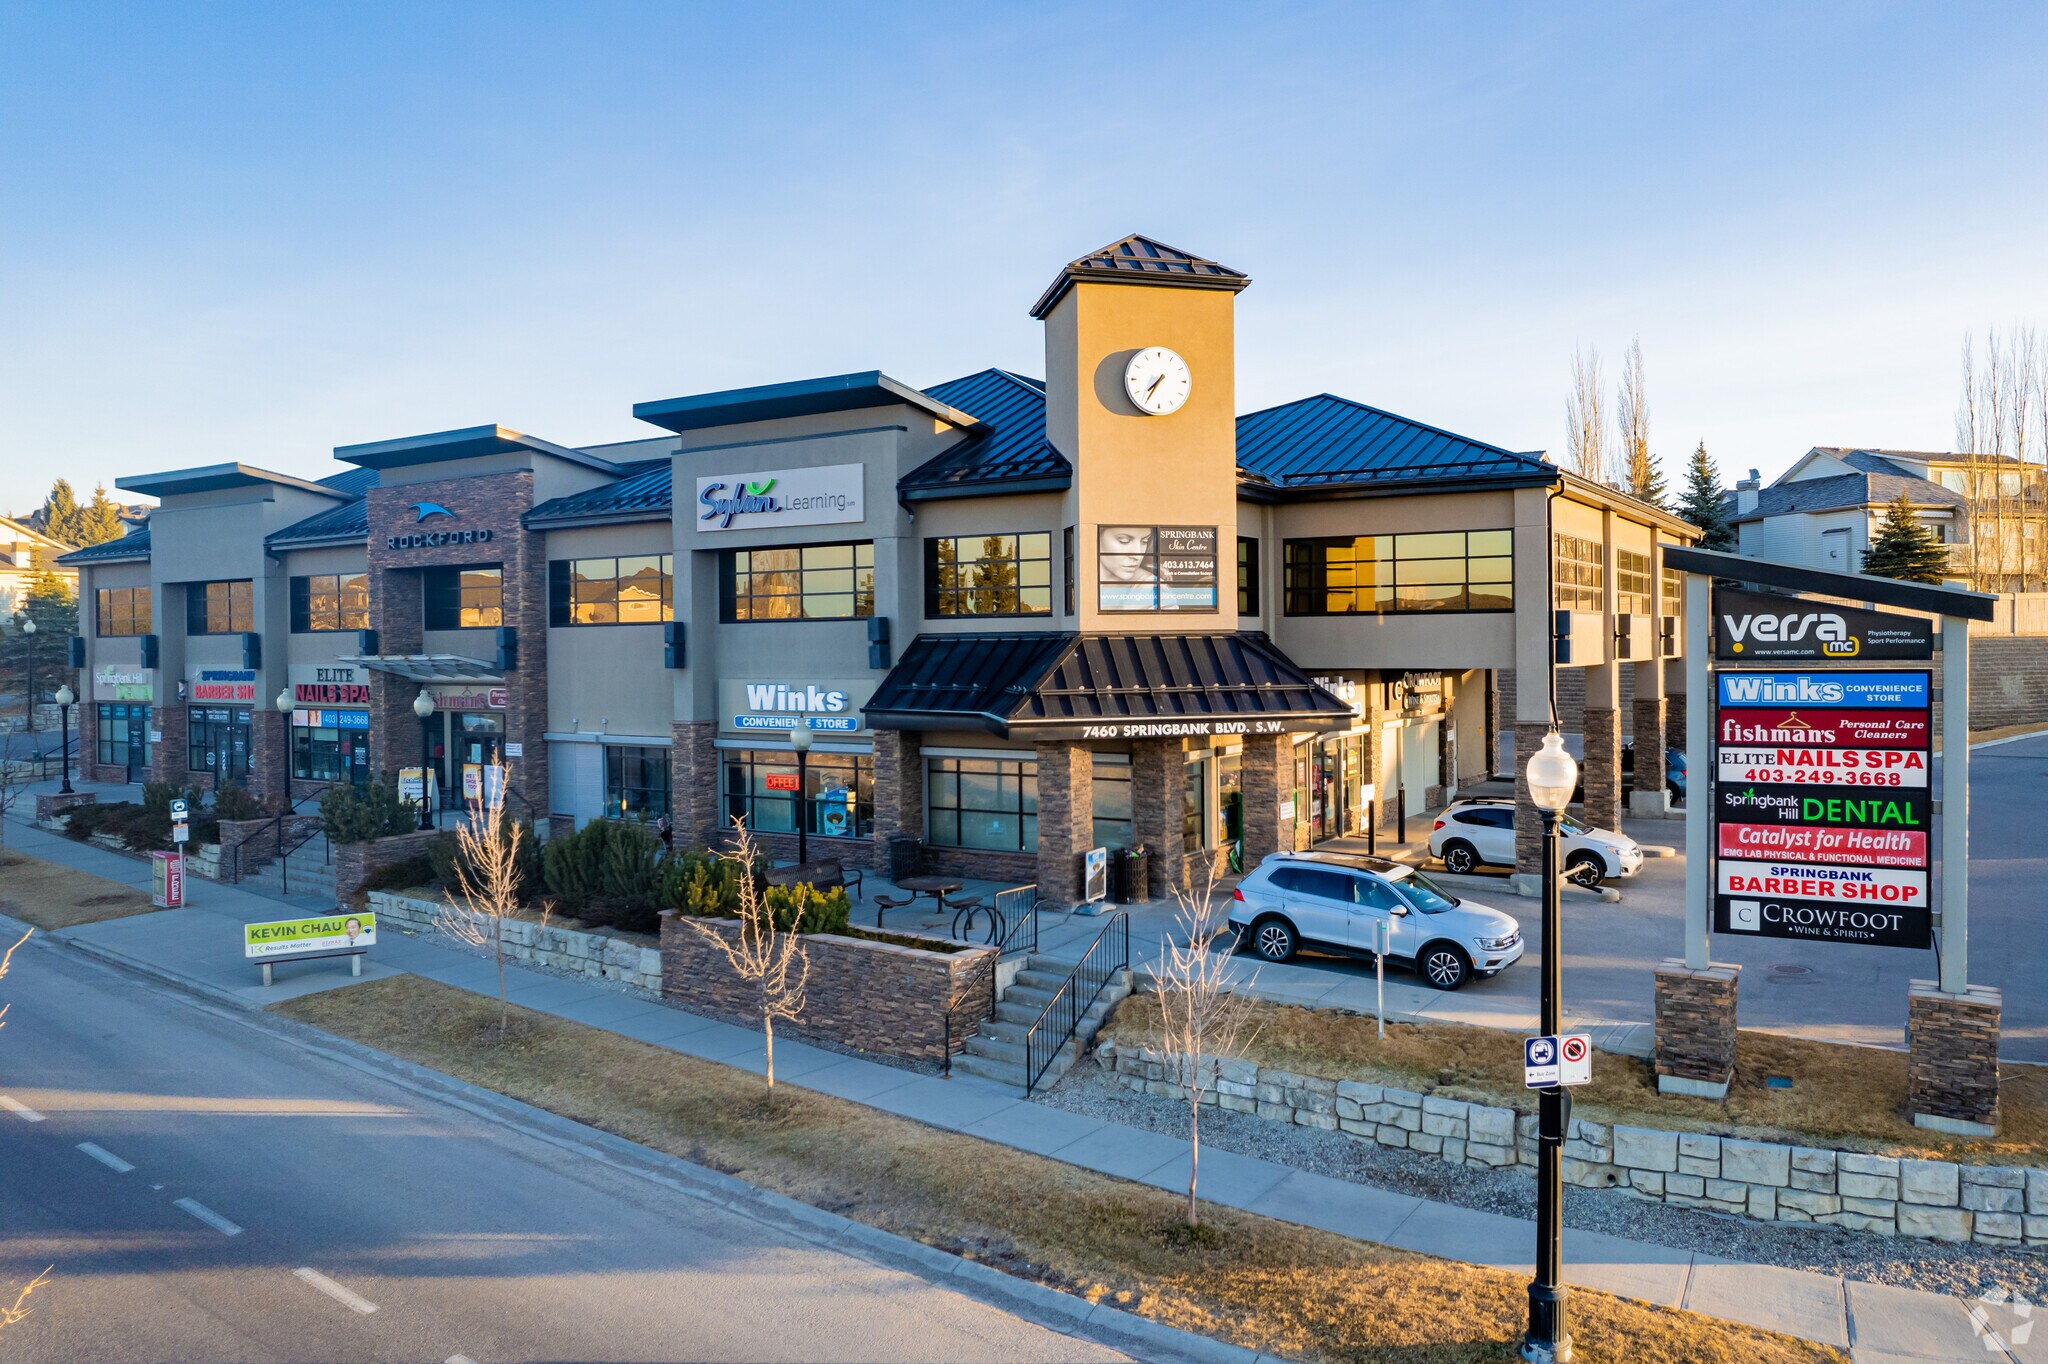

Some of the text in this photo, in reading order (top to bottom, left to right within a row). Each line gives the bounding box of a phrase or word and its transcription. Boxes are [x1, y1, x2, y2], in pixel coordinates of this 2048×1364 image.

[700, 482, 782, 528] Sylvan
[785, 493, 846, 511] Learning
[386, 529, 492, 549] ROCKFORD
[1160, 530, 1214, 539] SPRINGBANK
[1168, 540, 1208, 550] Skin Centre
[1162, 560, 1214, 568] 403.613.7464
[1724, 613, 1847, 642] versa
[1868, 630, 1912, 638] Physiotherapy
[1830, 640, 1853, 652] mc
[96, 672, 130, 686] Springbank
[316, 668, 354, 682] ELITE
[1404, 671, 1441, 689] CROWFOOT
[194, 685, 234, 700] BARBER
[296, 684, 369, 704] NAILS SPA
[1723, 676, 1844, 702] Winks
[1846, 684, 1922, 692] CONVENIENCE
[746, 684, 846, 712] Winks
[1866, 694, 1902, 702] STORE
[322, 714, 368, 724] (403) 249-3668
[742, 717, 848, 728] CONVENIENE STORE
[1839, 720, 1924, 730] Personal Care
[1083, 721, 1286, 738] 7460 SPRINGBANK BLVD. S.W.
[1723, 718, 1836, 743] fishman's
[1854, 730, 1908, 740] Cleaners
[1720, 749, 1924, 770] ELITE NAILS SPA
[1744, 769, 1901, 786] 403-249-3668
[1725, 790, 1798, 808] Springbank
[1778, 808, 1798, 820] Hill
[1803, 798, 1919, 825] DENTAL
[1738, 828, 1912, 850] Catalyst for Health
[1724, 848, 1922, 866] EMG LAB PHYSICAL & FUNCTIONAL MEDICINE
[1770, 866, 1873, 882] SPRINGBANK
[172, 874, 180, 900] FREE
[1729, 876, 1918, 902] BARBER SHOP
[1763, 904, 1902, 931] CROWFOOT
[251, 922, 342, 939] KEVIN CHAU
[1794, 925, 1869, 939] WINE & SPIRITS
